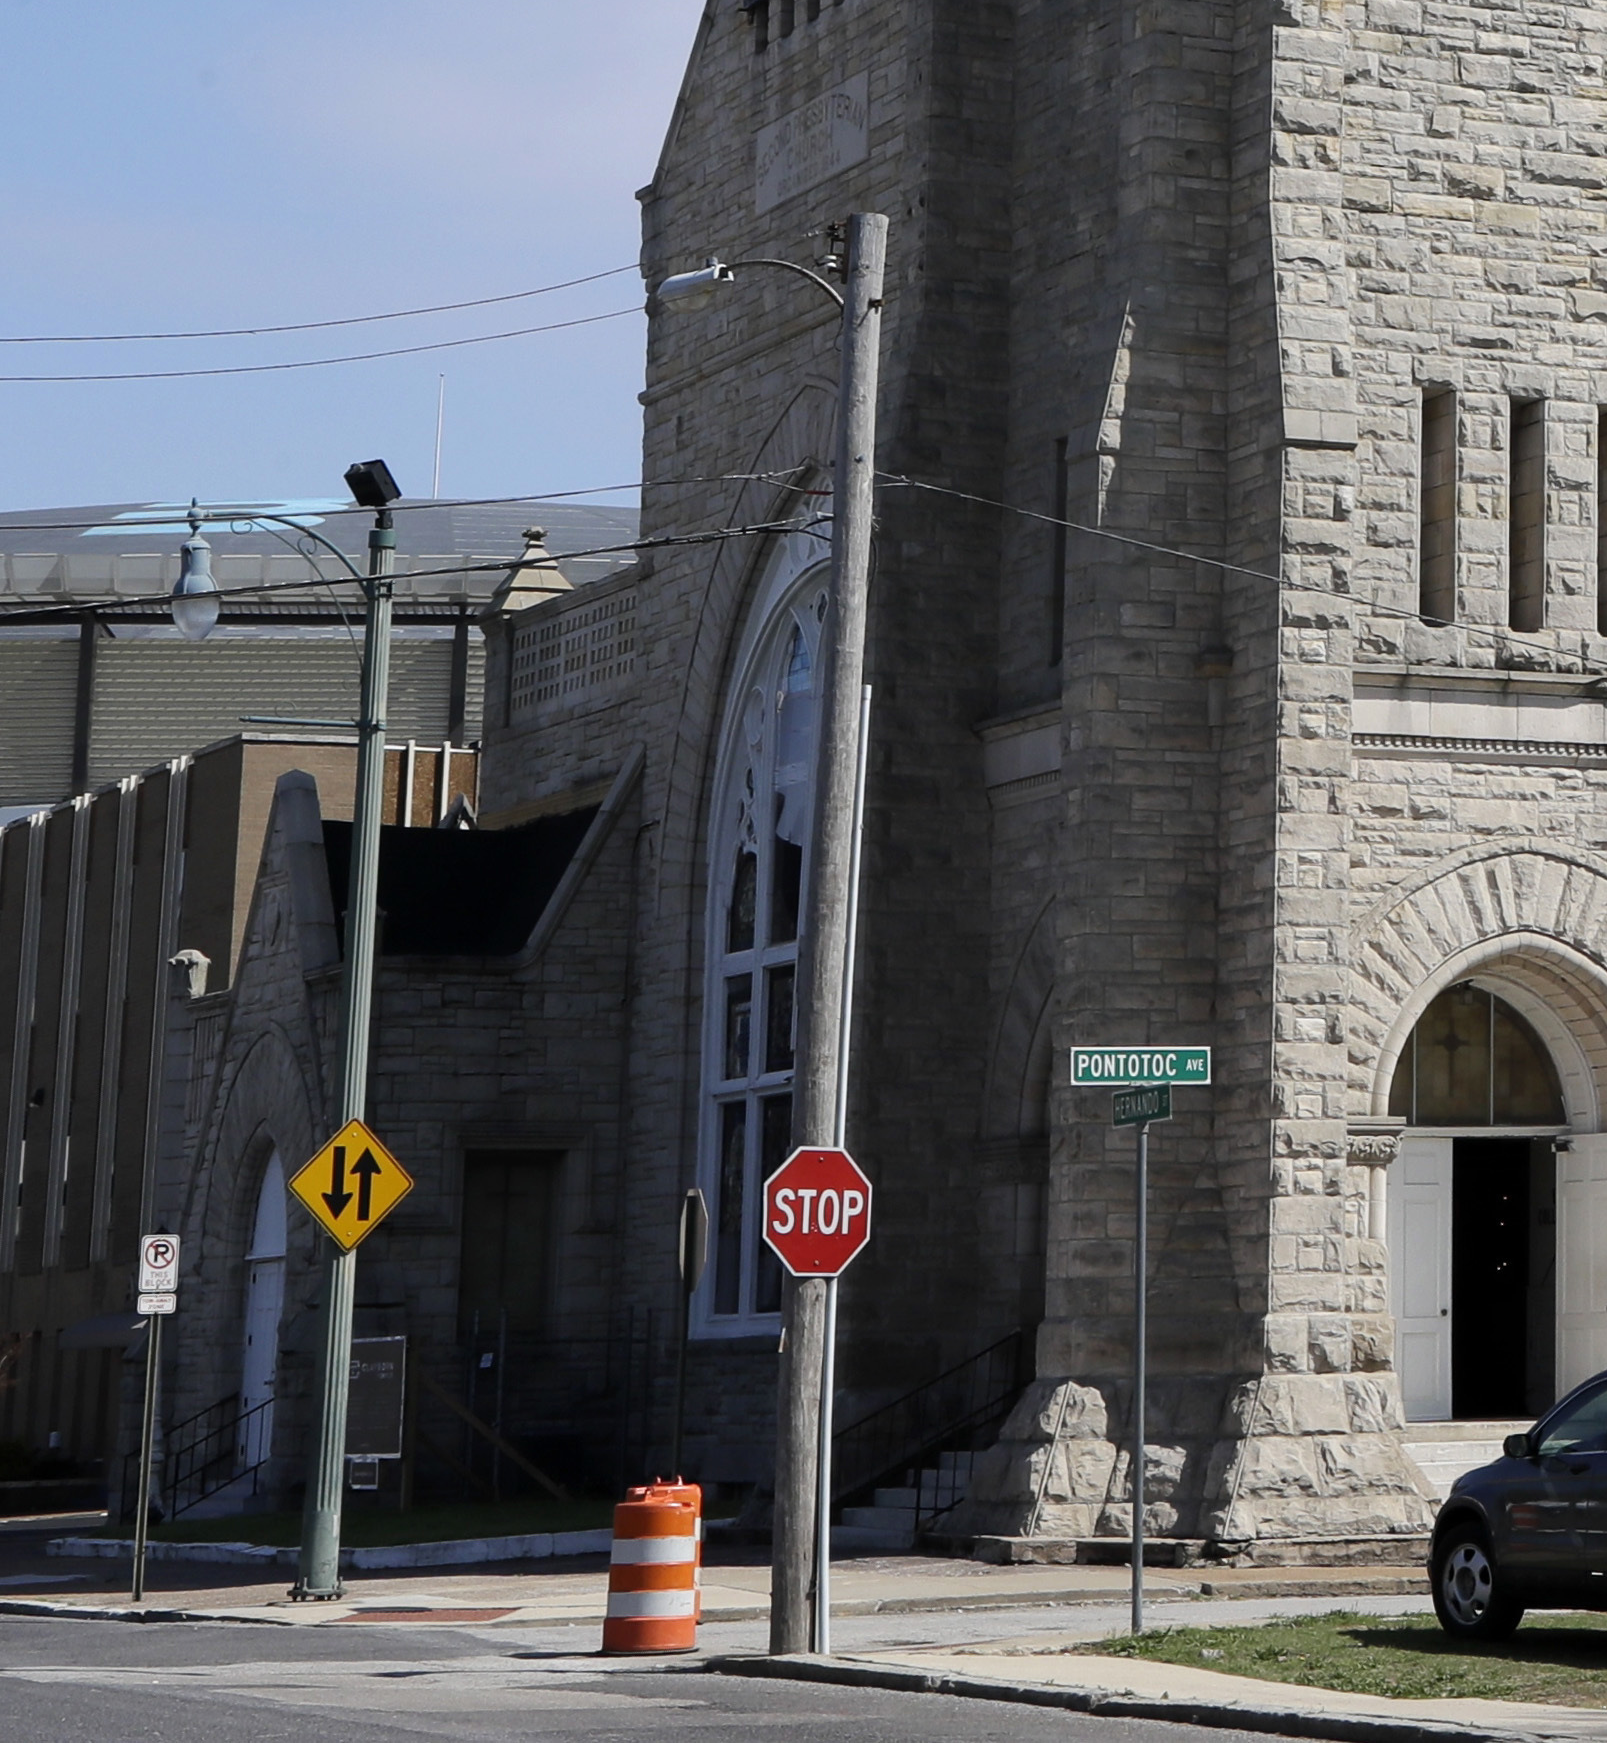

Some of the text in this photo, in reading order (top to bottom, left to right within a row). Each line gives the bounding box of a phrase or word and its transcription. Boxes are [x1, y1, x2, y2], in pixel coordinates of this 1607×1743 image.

[787, 123, 833, 170] CHURCH
[1078, 1053, 1204, 1077] PONTOTOC AVE
[1115, 1091, 1160, 1119] HERNANDO
[772, 1188, 864, 1235] STOP
[145, 1279, 172, 1287] BLOCK
